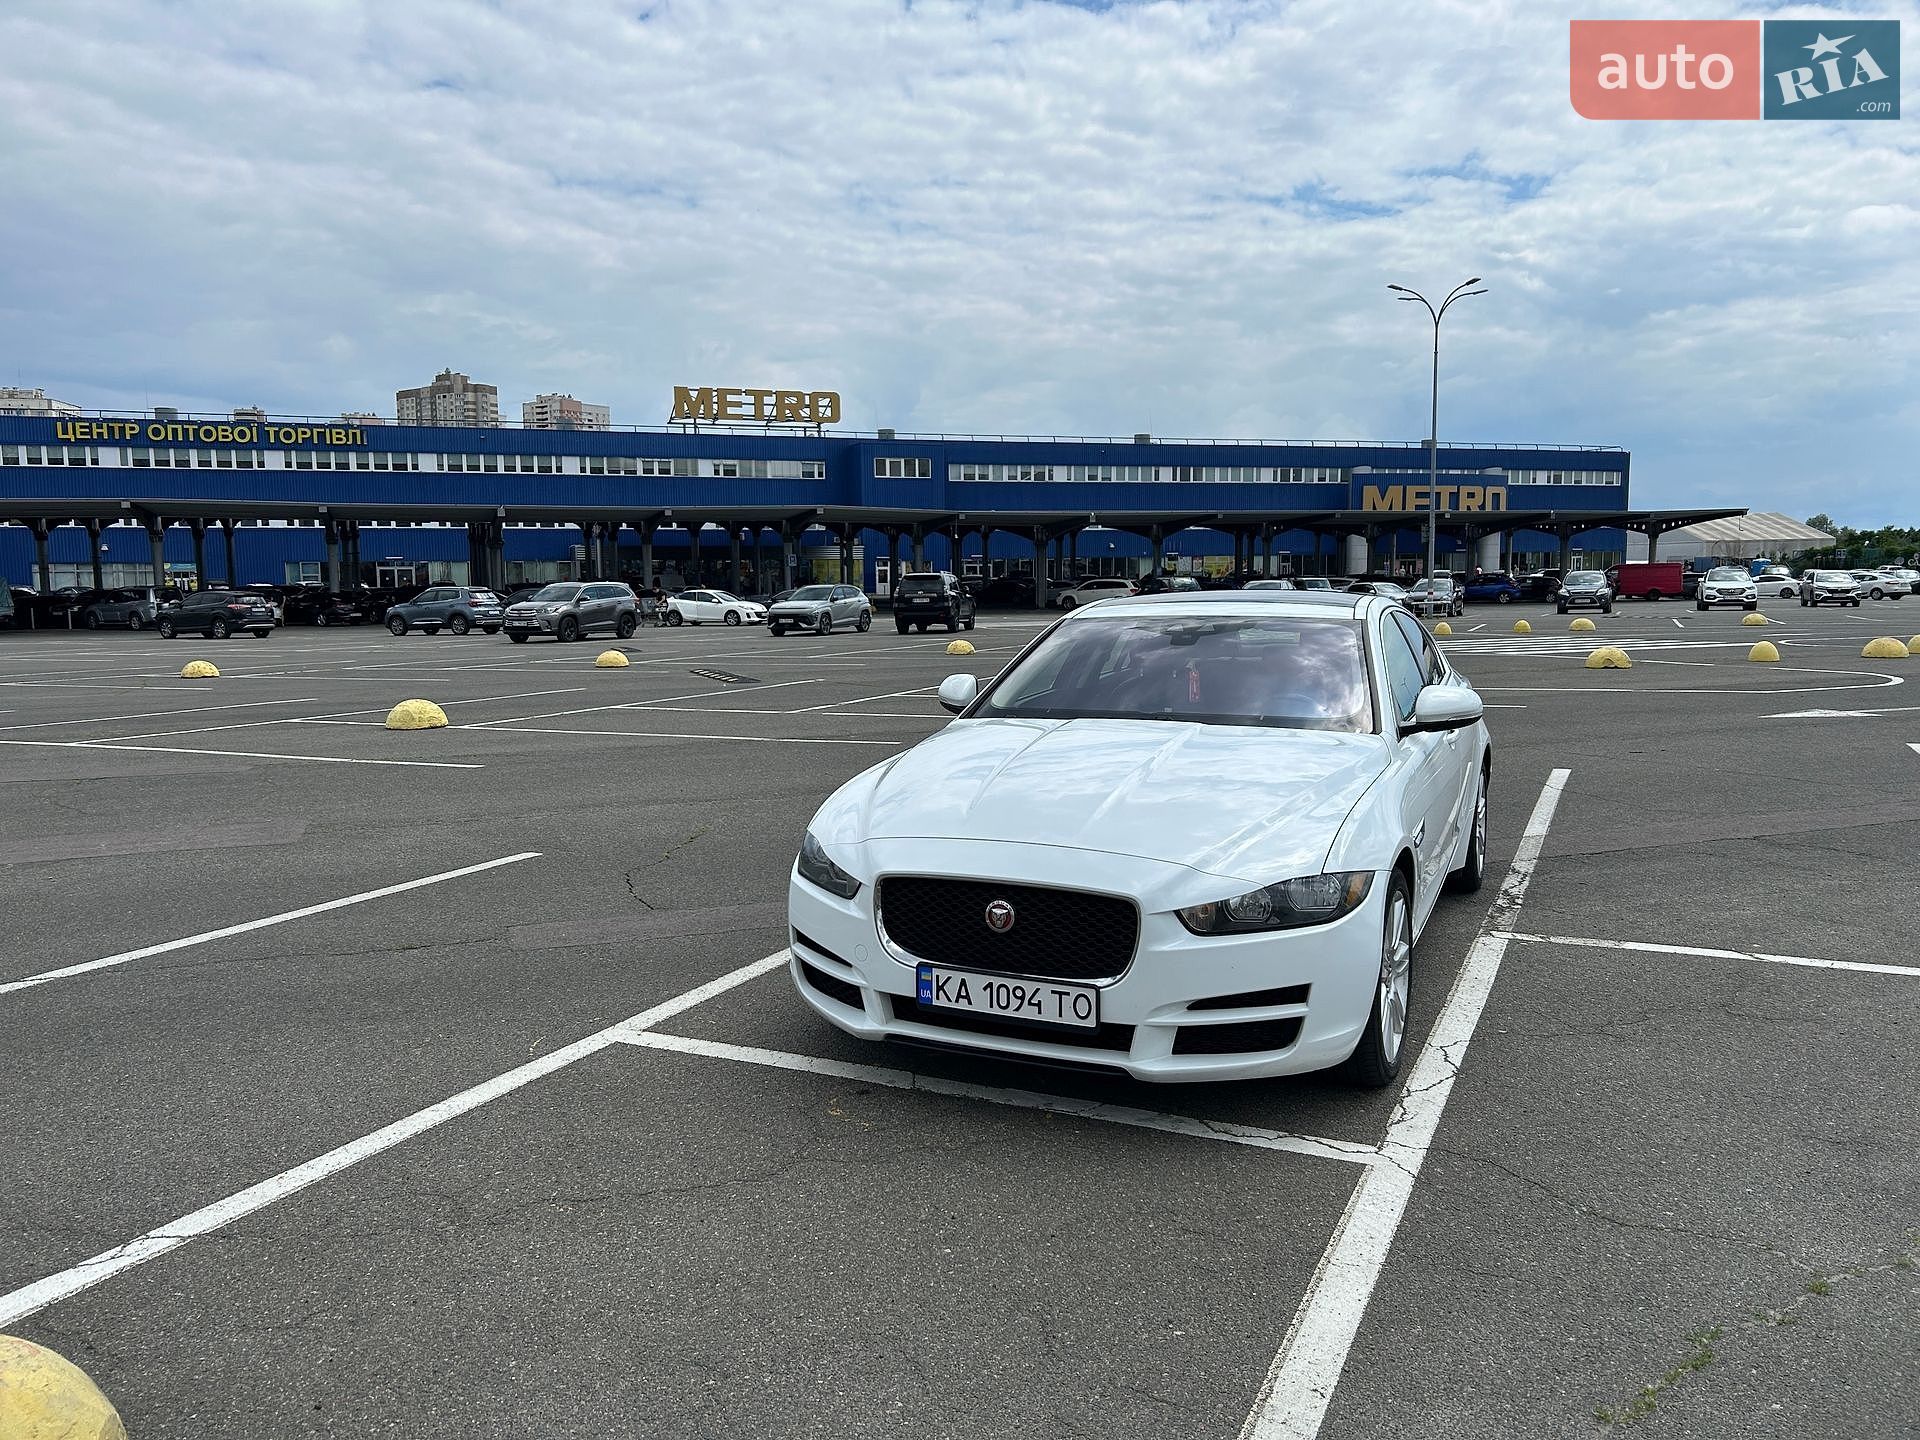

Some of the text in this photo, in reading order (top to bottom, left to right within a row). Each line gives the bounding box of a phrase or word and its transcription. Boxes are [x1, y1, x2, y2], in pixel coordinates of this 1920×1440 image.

[674, 386, 841, 424] METRO
[56, 421, 140, 442] ЦЕНТР
[147, 423, 259, 444] ОПТОВОЇ
[1362, 485, 1508, 512] METRO
[920, 988, 932, 999] UA
[935, 974, 1093, 1020] KA 1094 TO
